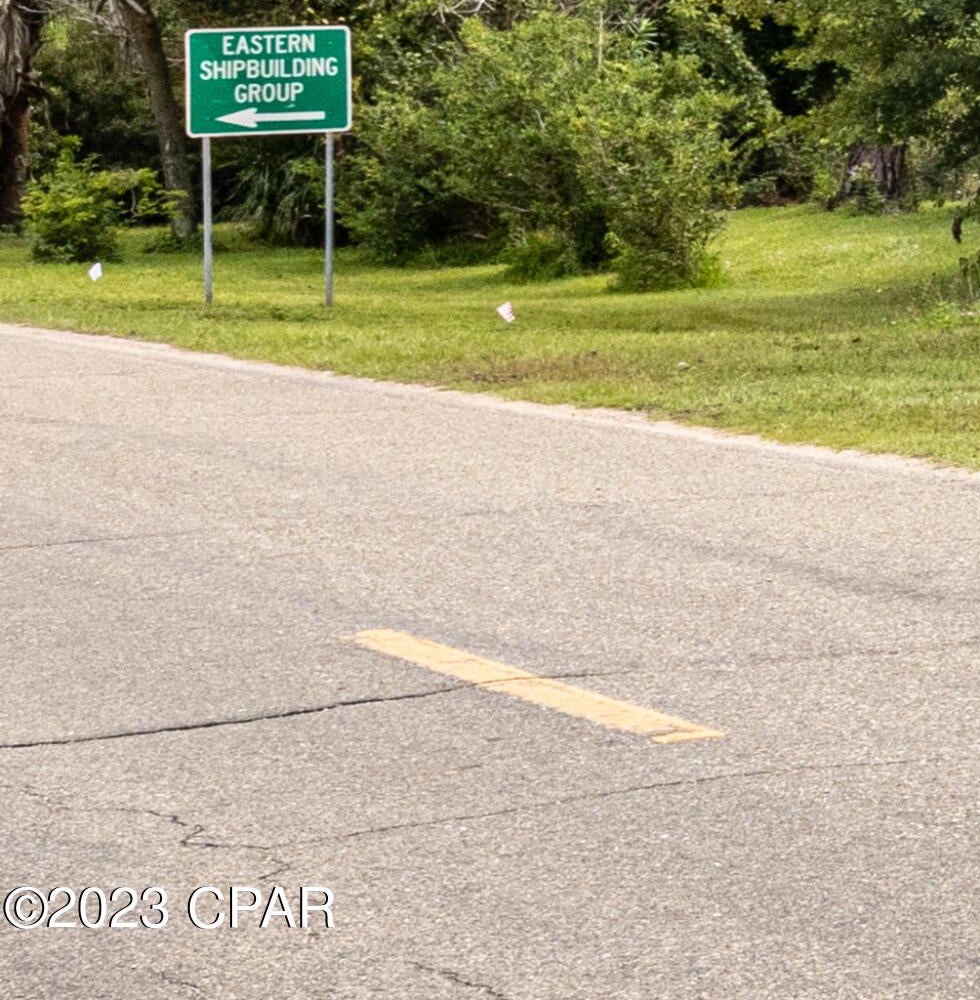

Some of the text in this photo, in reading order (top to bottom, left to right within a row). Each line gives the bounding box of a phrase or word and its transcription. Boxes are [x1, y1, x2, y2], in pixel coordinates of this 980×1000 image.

[222, 33, 316, 55] EASTERN
[199, 56, 339, 80] SHIPBUILDING
[234, 82, 304, 105] GROUP
